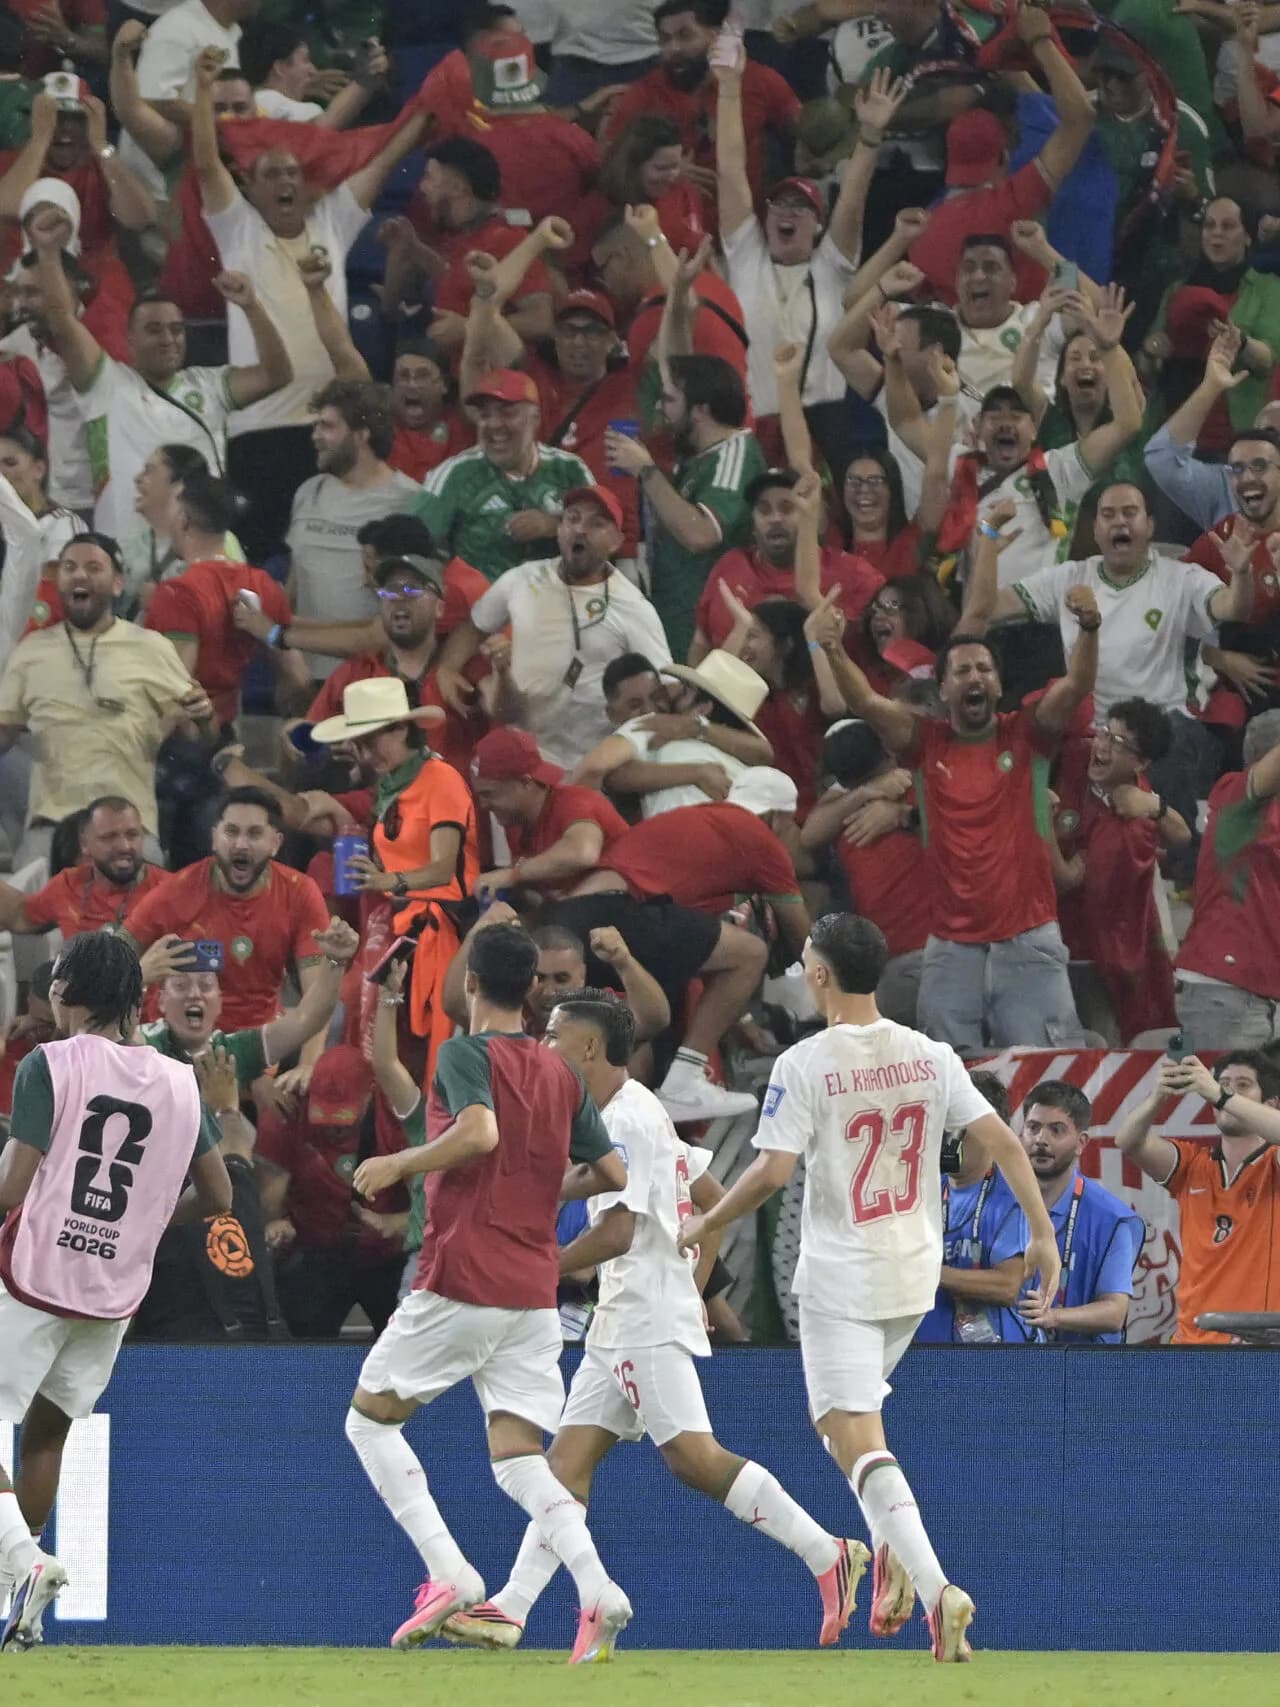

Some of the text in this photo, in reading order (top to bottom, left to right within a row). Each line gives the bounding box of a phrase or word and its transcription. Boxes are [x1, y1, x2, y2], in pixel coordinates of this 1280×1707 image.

[824, 1060, 937, 1096] EL KHANNOUSS
[845, 1100, 929, 1227] 23
[84, 1191, 112, 1212] FIFA
[98, 1226, 120, 1241] CUP
[1211, 1213, 1234, 1243] 8
[56, 1230, 117, 1260] 2026
